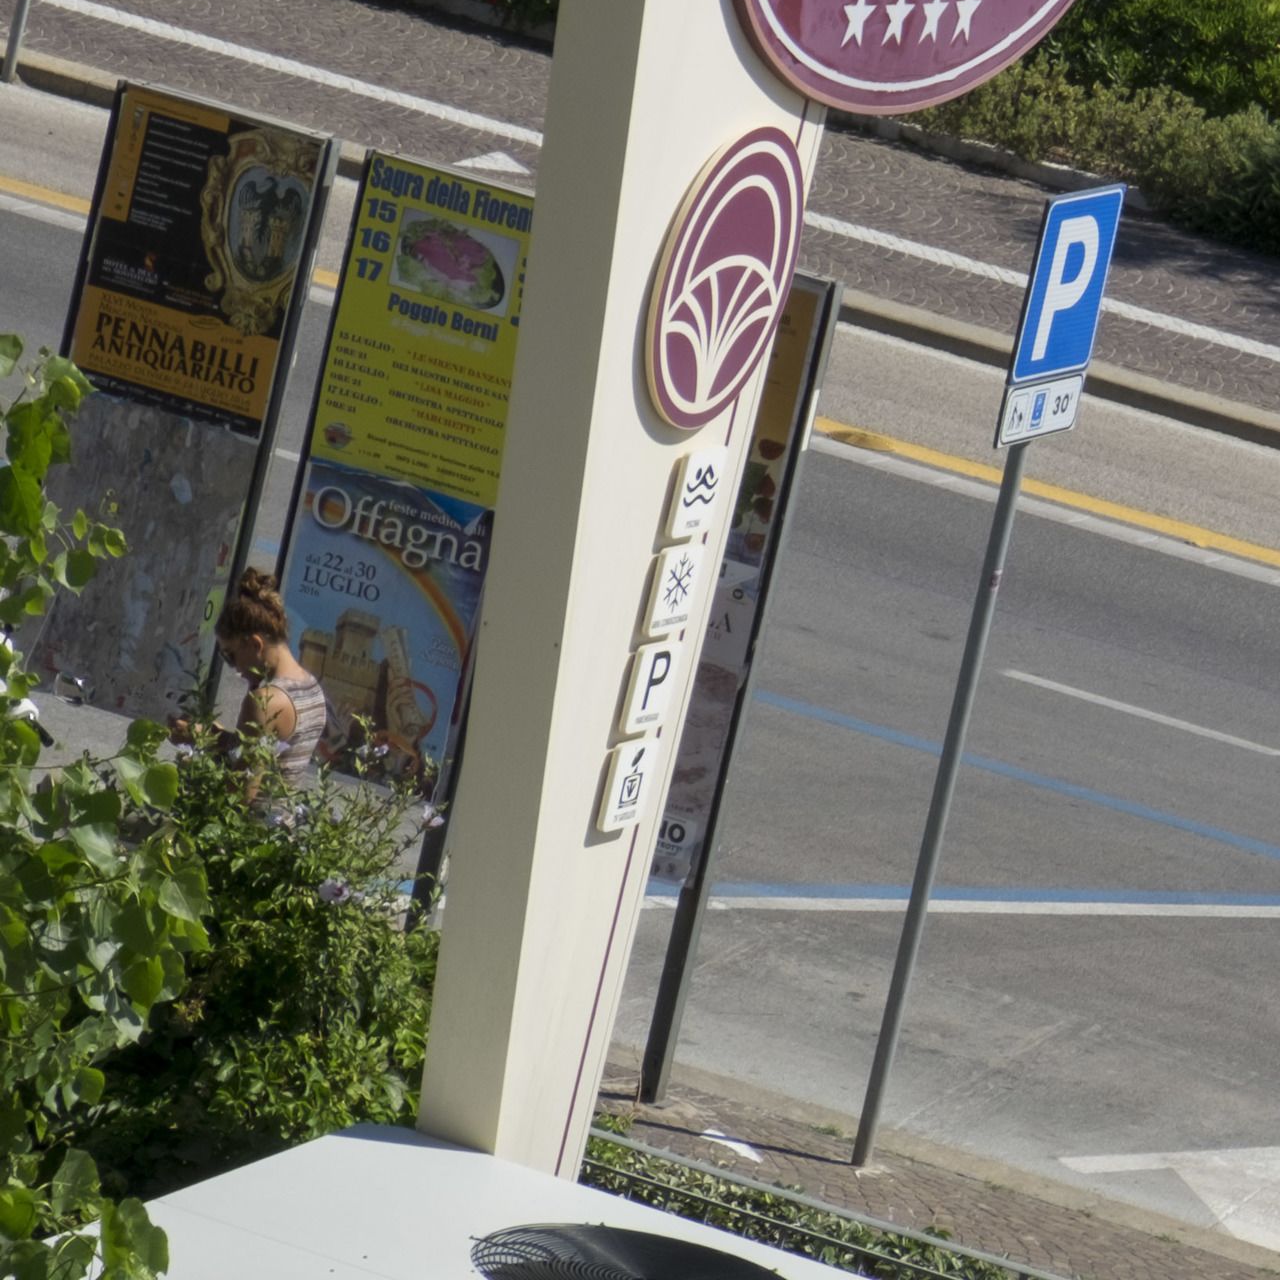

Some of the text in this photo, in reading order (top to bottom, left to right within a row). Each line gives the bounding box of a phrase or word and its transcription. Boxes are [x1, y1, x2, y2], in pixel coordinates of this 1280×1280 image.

[367, 197, 397, 223] 15
[370, 158, 424, 199] Sagra
[425, 175, 470, 215] della
[360, 227, 392, 254] 16
[355, 257, 384, 282] 17
[1030, 214, 1101, 362] P
[388, 292, 448, 328] Poggio
[451, 312, 499, 342] Berni
[92, 335, 256, 395] ANTIQUARIATO
[96, 313, 260, 379] PENNABILLI
[312, 485, 484, 572] Offagna
[389, 501, 487, 538] feste medioli
[302, 566, 381, 603] LUGLIO
[305, 554, 321, 566] dal
[323, 552, 344, 572] 22
[355, 560, 377, 582] 30
[641, 650, 672, 711] P
